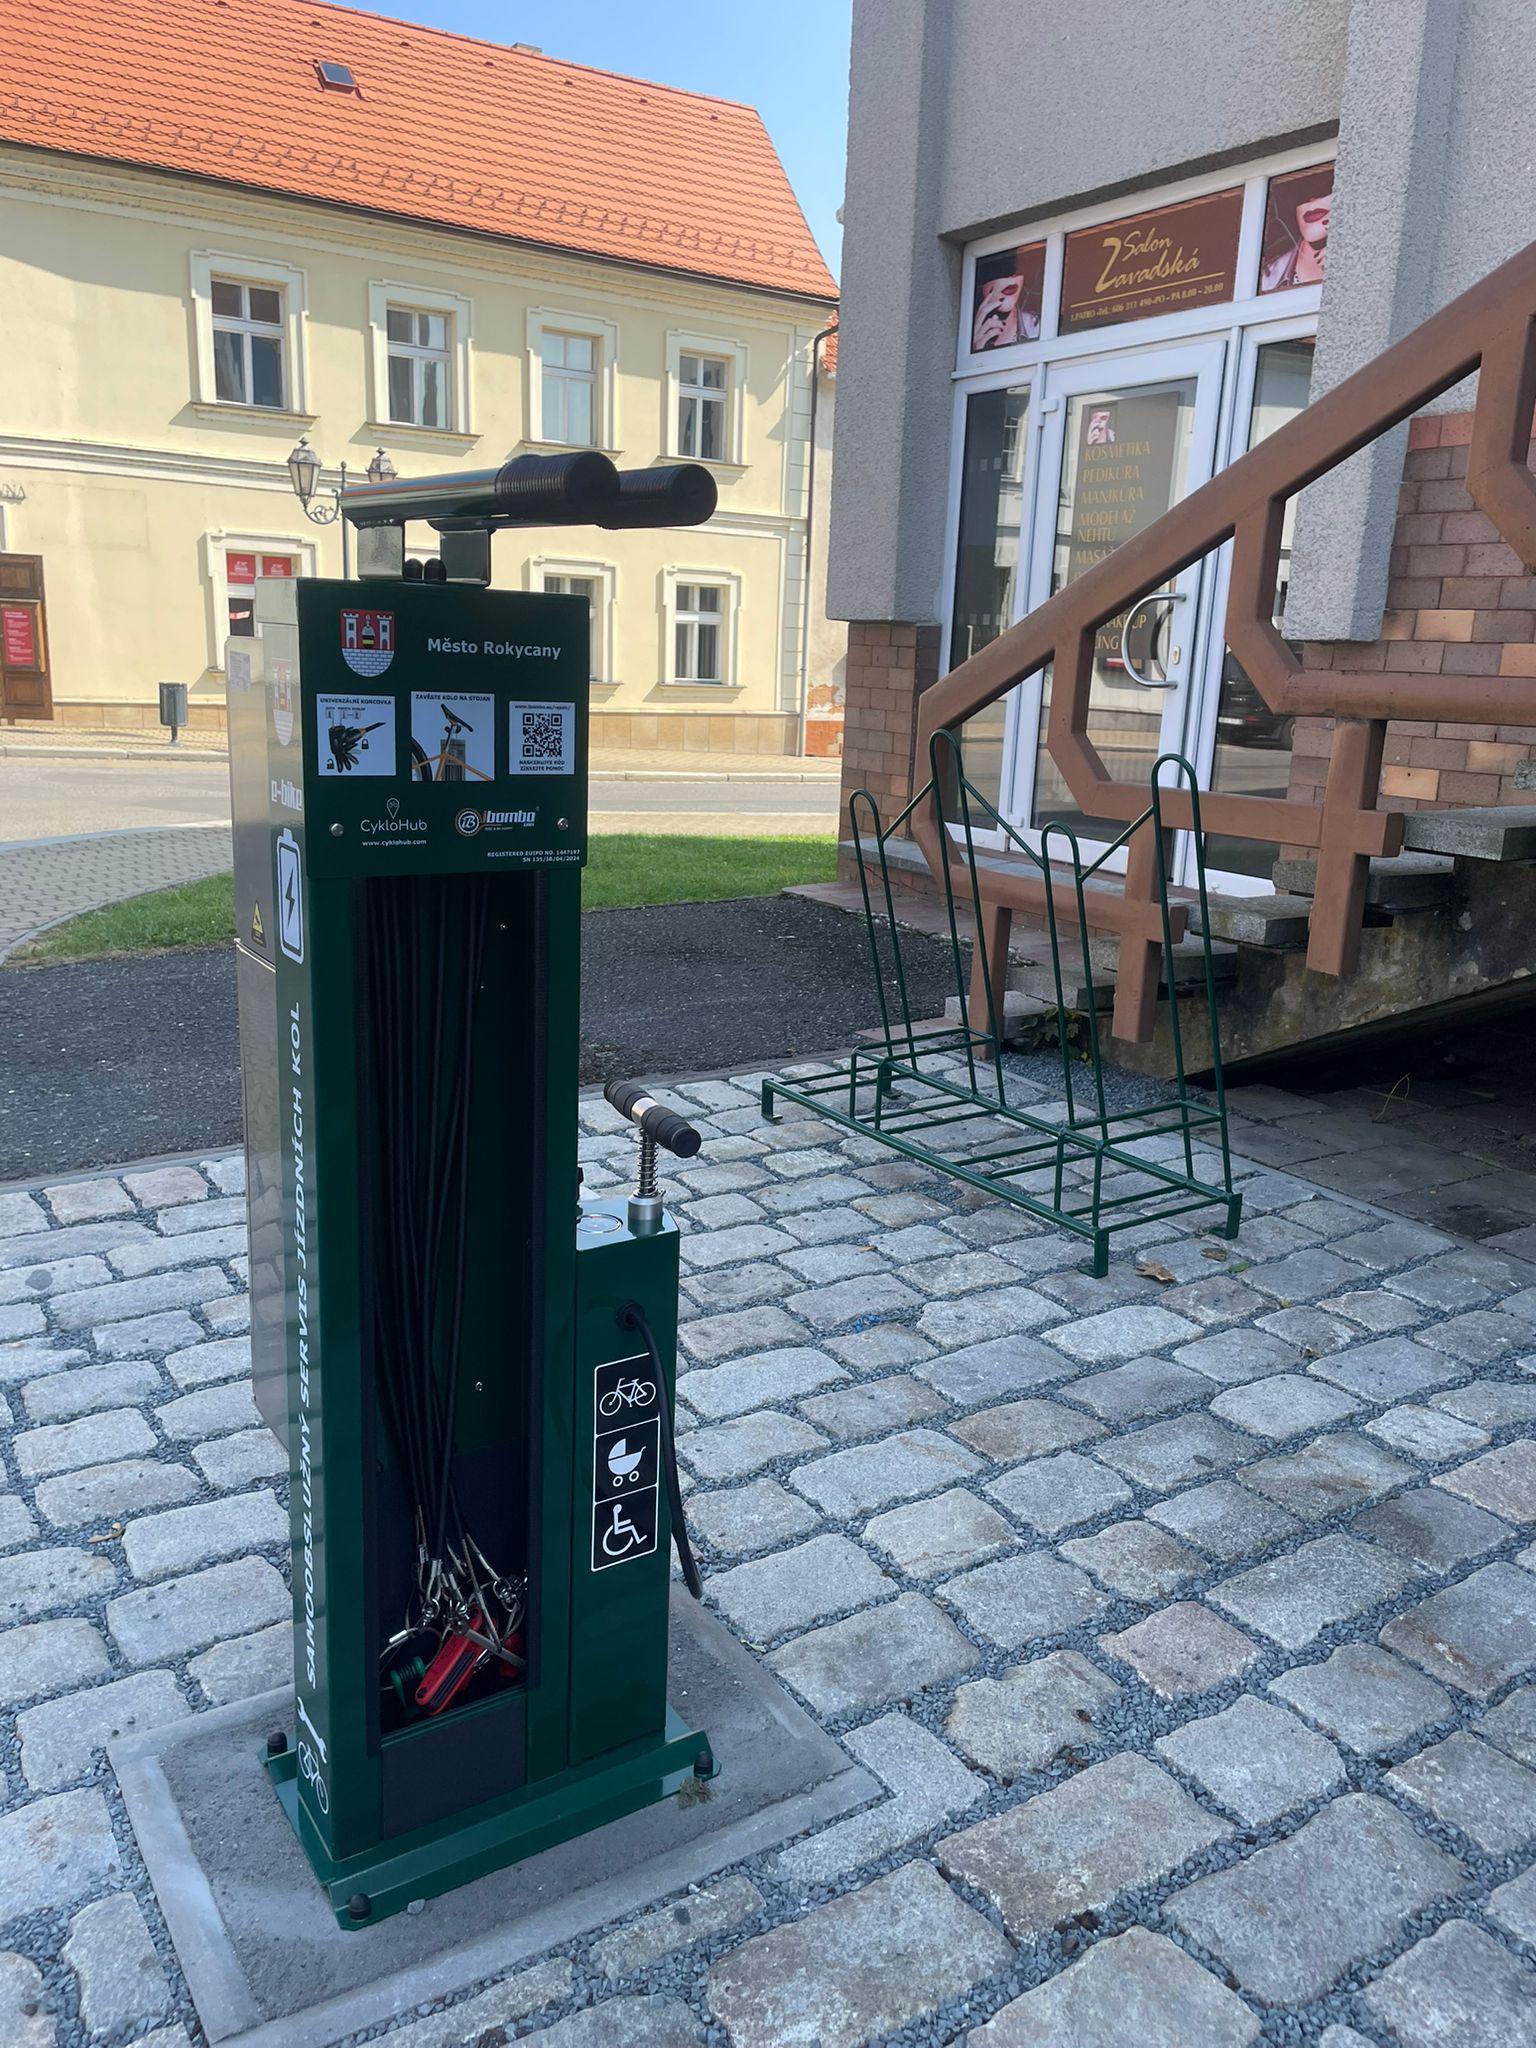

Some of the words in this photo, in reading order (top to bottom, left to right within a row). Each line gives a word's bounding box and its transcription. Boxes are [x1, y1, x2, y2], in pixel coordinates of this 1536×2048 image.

[1122, 227, 1173, 262] Salon
[1085, 440, 1151, 462] KOSMETIKA
[427, 637, 478, 654] Město
[483, 640, 561, 660] Rokycany
[360, 819, 428, 835] CykloHub
[361, 839, 427, 847] www.cyklohub.com
[290, 1001, 301, 1076] KOL
[292, 1086, 306, 1269] JÍZDNÍCH
[297, 1275, 309, 1408] SERVIS
[299, 1411, 316, 1689] SAMOOBSLUŽNÝ
